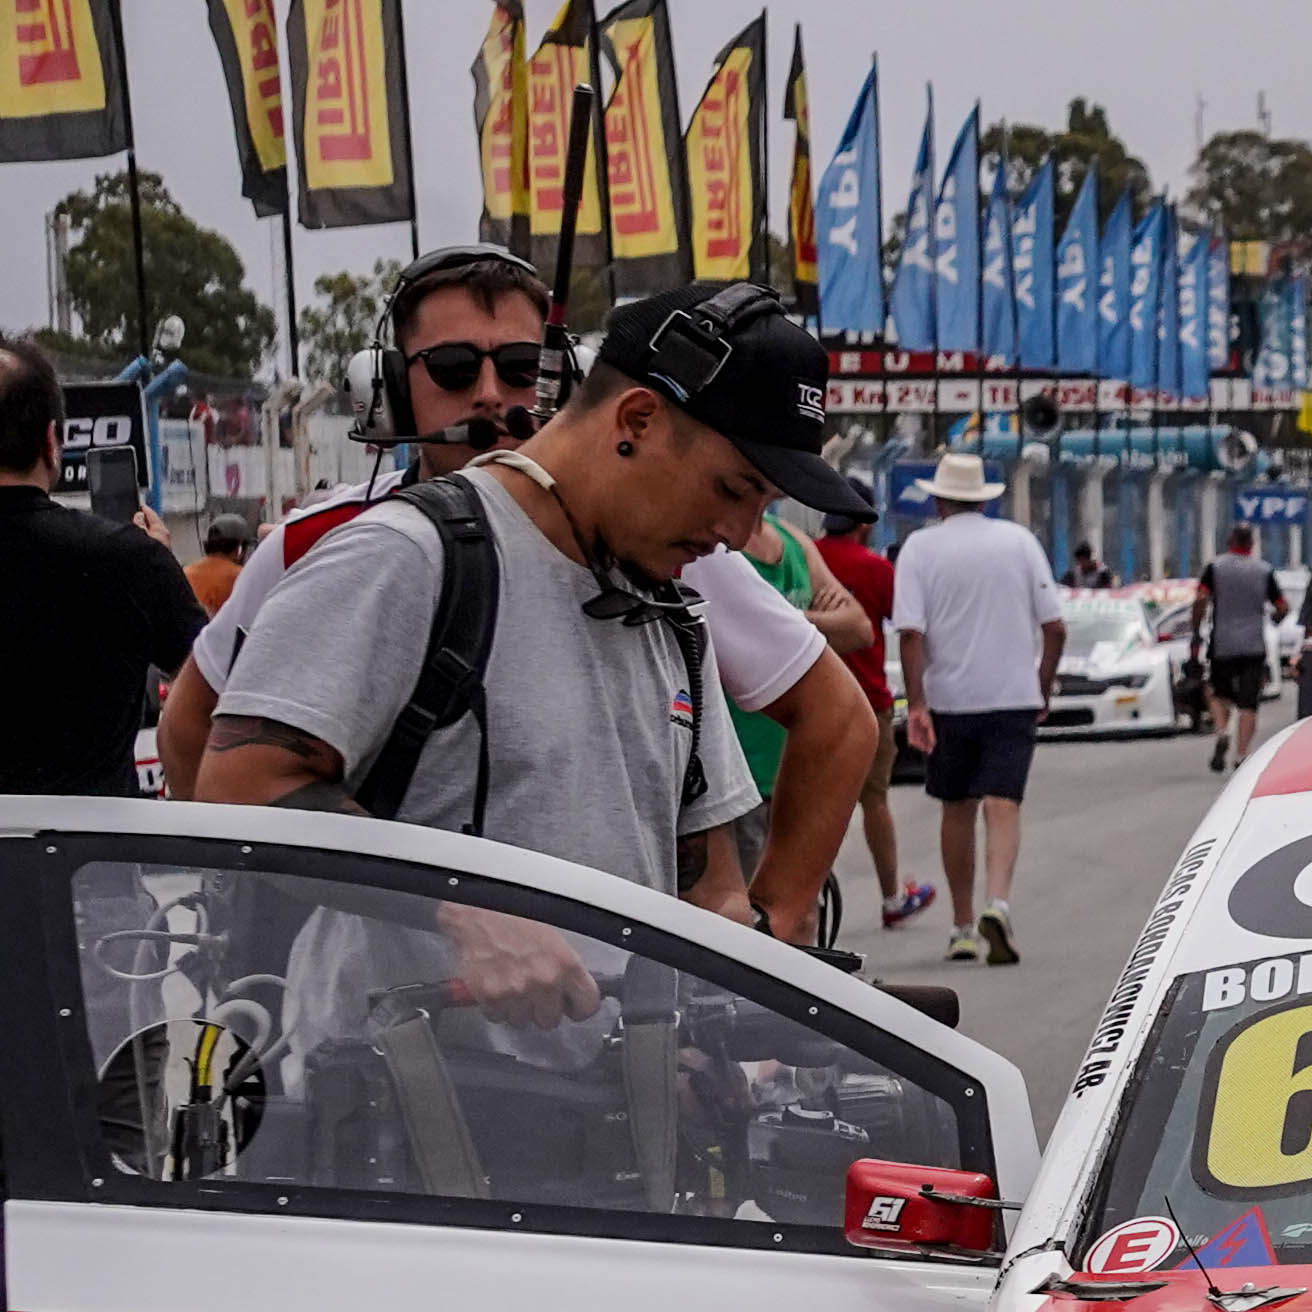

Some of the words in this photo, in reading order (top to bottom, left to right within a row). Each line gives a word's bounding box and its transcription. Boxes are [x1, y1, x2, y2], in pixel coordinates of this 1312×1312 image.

[1237, 496, 1307, 518] YPF
[1158, 837, 1217, 905] LUCAS
[1085, 899, 1184, 1062] BOHDANOWICZ
[868, 1197, 906, 1223] 61
[1101, 1229, 1162, 1272] E
